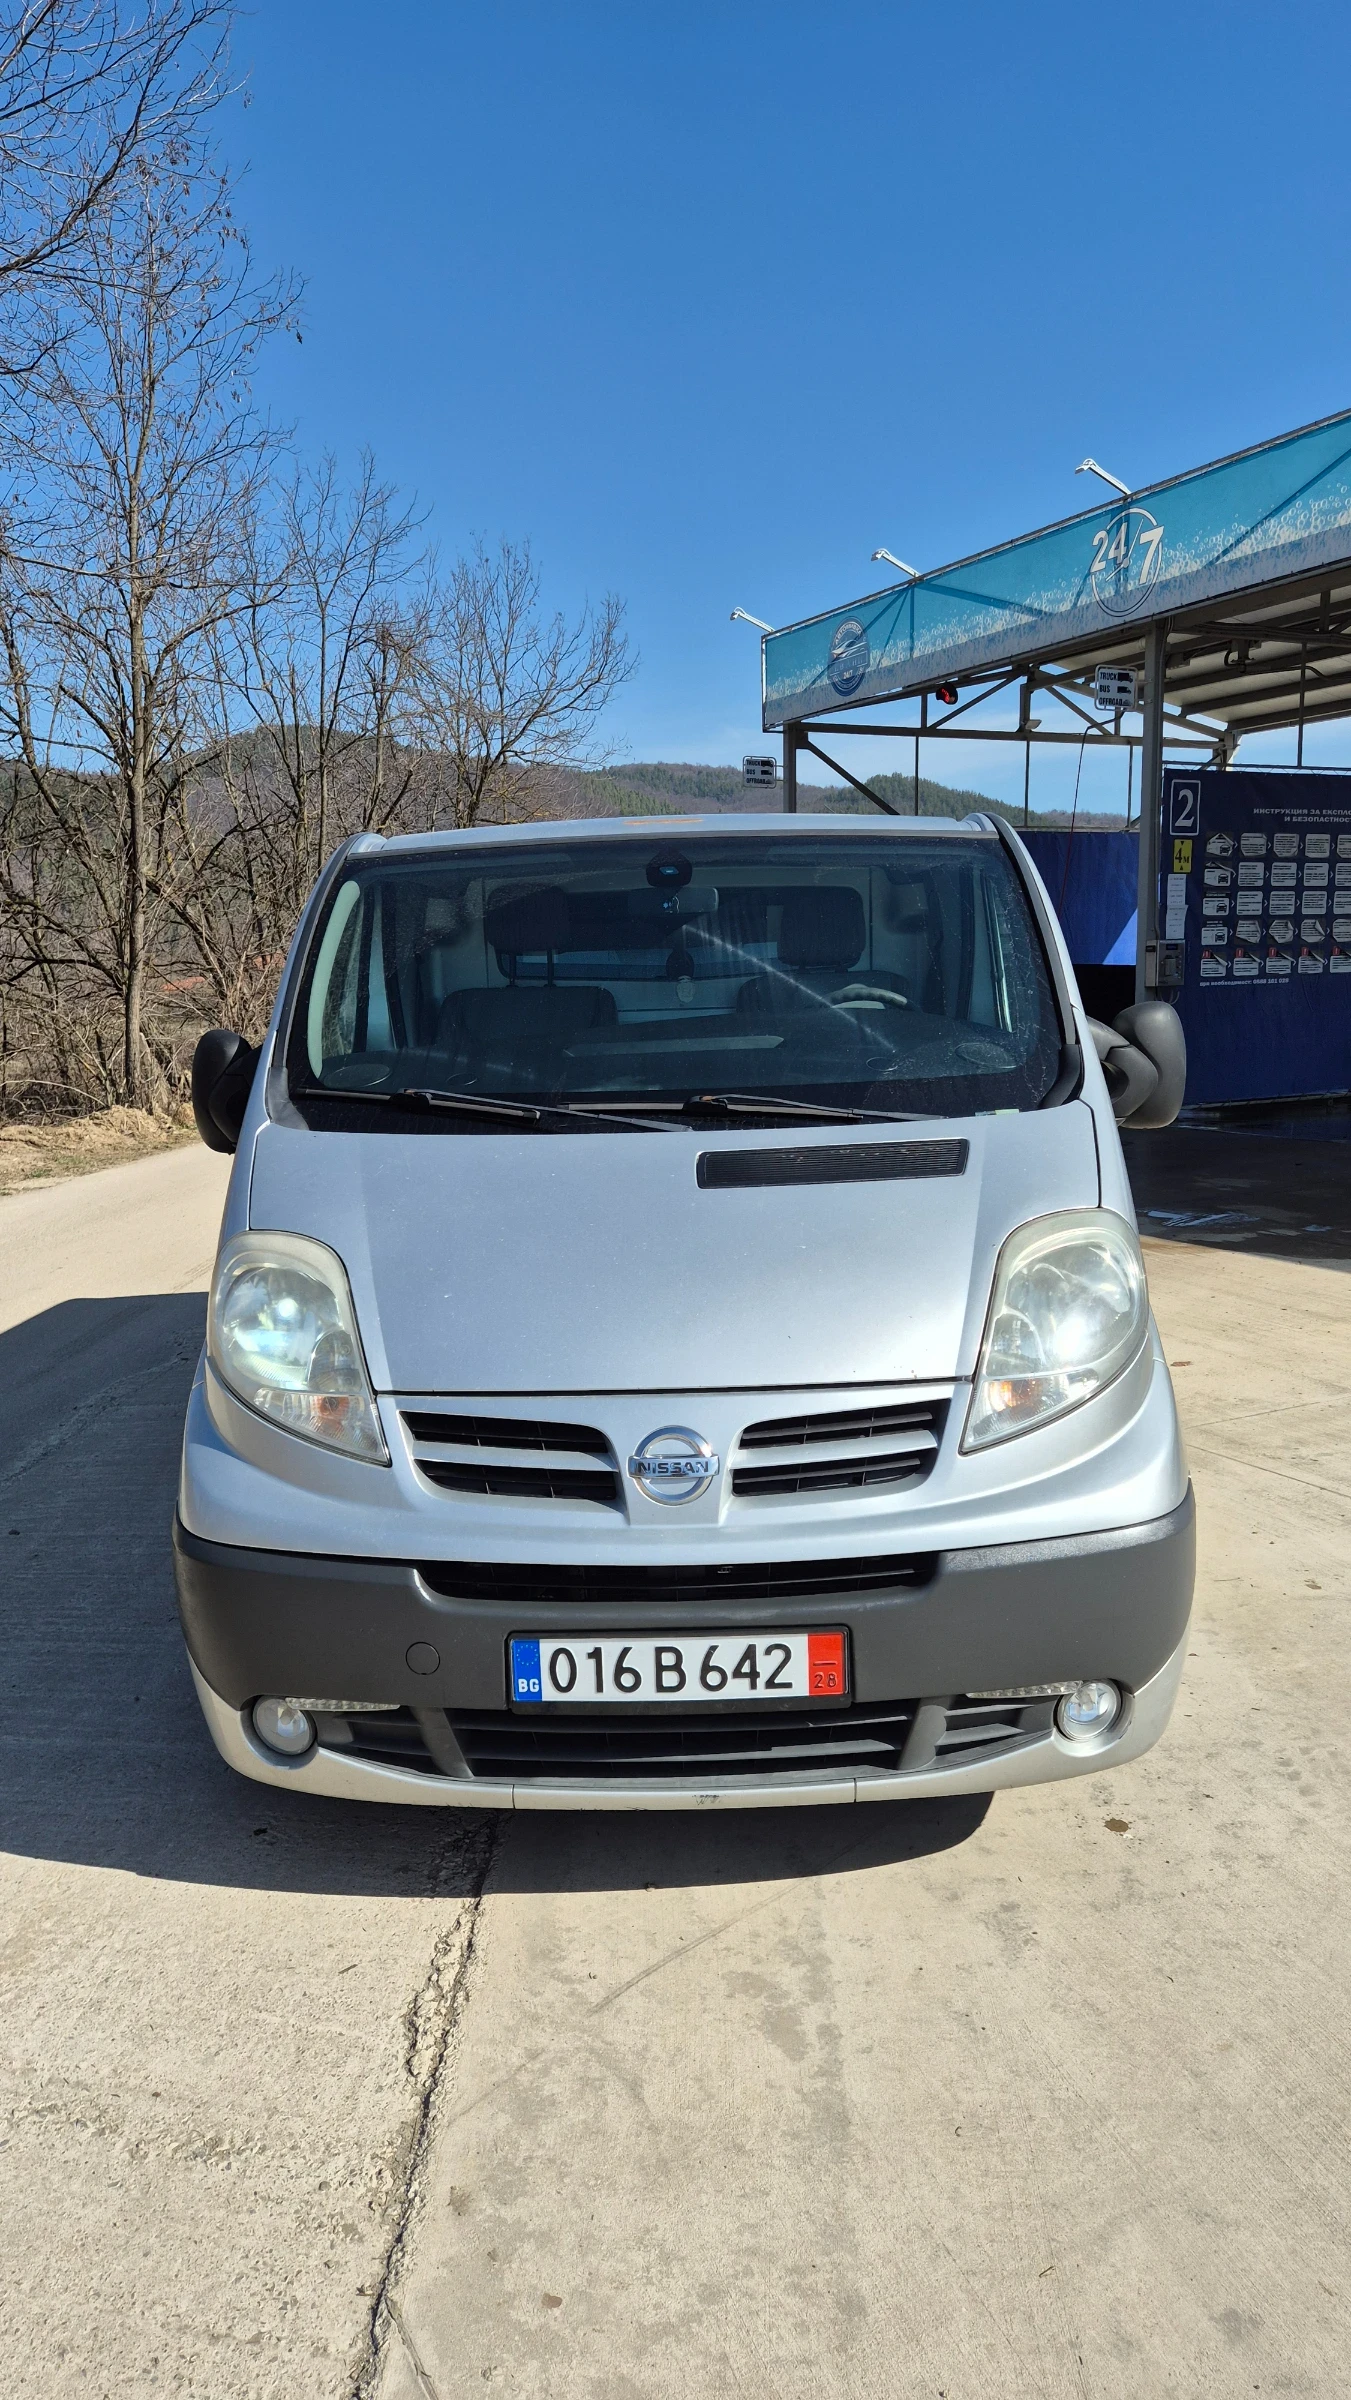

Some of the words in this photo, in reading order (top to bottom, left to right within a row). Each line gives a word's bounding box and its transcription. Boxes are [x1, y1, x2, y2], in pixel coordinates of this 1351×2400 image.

[1100, 672, 1117, 681] TRUCK
[1099, 698, 1123, 706] OFFROAD
[1174, 788, 1195, 827] 2
[637, 1461, 709, 1474] NISSAN
[518, 1678, 539, 1693] BG
[813, 1672, 836, 1689] 28
